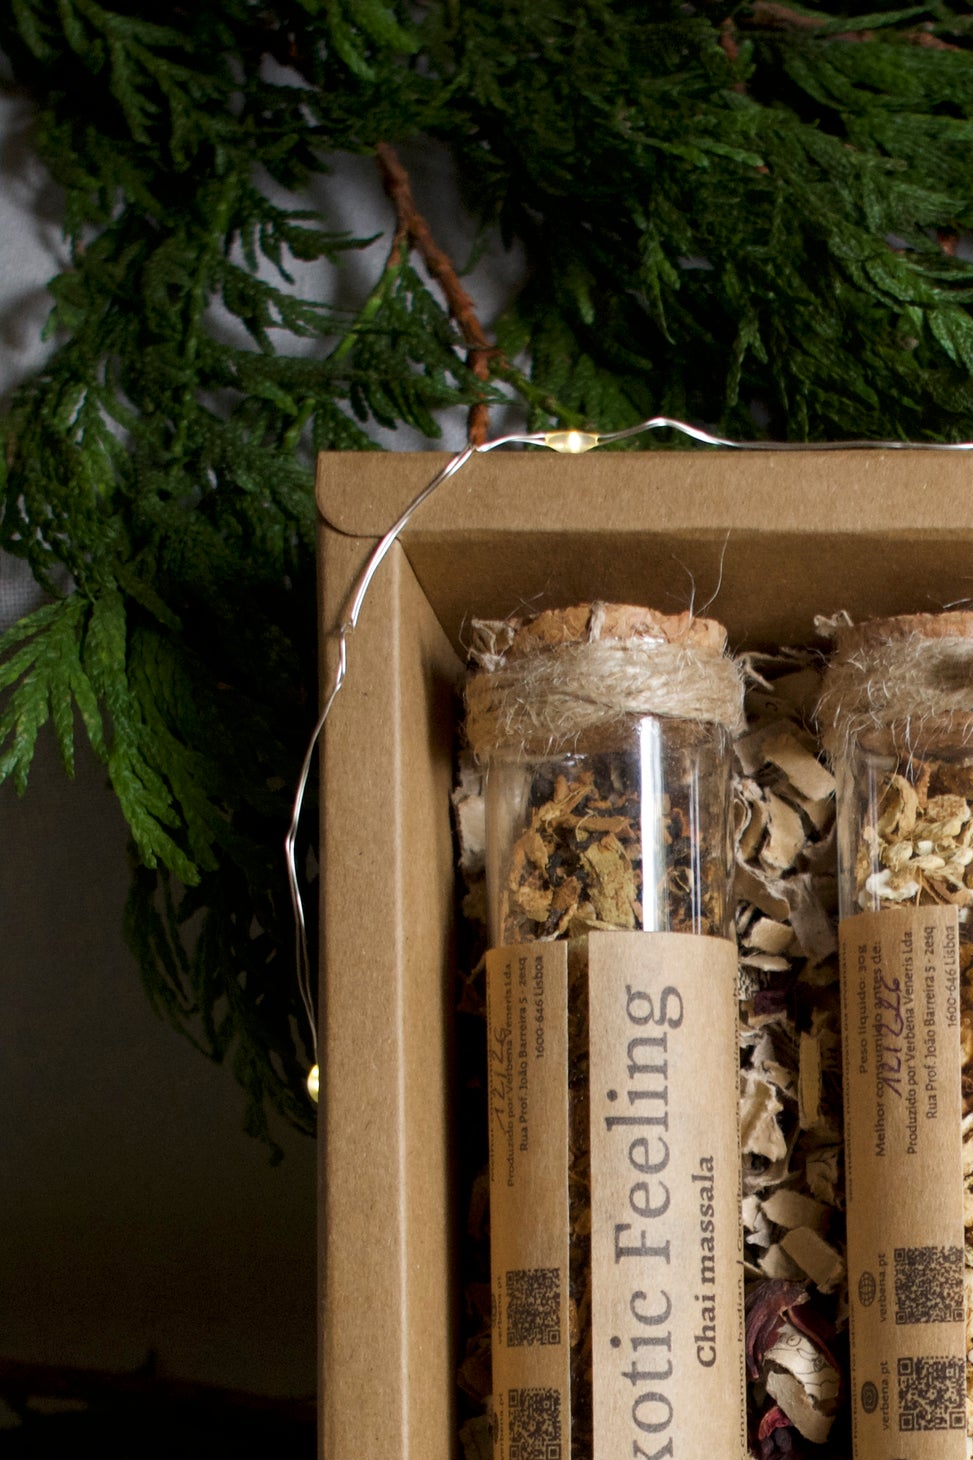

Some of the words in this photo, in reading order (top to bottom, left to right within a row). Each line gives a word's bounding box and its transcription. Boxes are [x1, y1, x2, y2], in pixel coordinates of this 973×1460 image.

[857, 944, 868, 973] 30g
[870, 940, 882, 964] de:
[924, 926, 936, 956] 2esq
[944, 925, 956, 965] Lisboa
[533, 956, 544, 997] Lisboa
[871, 968, 883, 1008] antes
[901, 956, 913, 1005] Veneris
[923, 975, 935, 1027] Barreira
[945, 968, 957, 1028] 1600-646
[503, 988, 513, 1037] Veneris
[534, 999, 545, 1058] 1600-646
[857, 977, 869, 1034] líquido:
[517, 1007, 528, 1059] Barreira
[859, 1039, 868, 1073] Peso
[871, 1014, 886, 1098] consumido
[903, 1008, 916, 1063] Verbena
[924, 1030, 937, 1058] João
[504, 1040, 513, 1095] Verbena
[518, 1061, 529, 1090] João
[906, 1065, 919, 1086] por
[925, 1062, 937, 1091] Prof.
[505, 1096, 516, 1118] por
[519, 1094, 529, 1124] Prof.
[605, 983, 684, 1264] Feeling
[873, 1102, 886, 1157] Melhor
[903, 1089, 917, 1154] Produzido
[926, 1095, 938, 1119] Rua
[504, 1123, 515, 1187] Produzido
[519, 1127, 529, 1152] Rua
[691, 1156, 717, 1286] massala
[877, 1253, 888, 1322] verbena.pt
[691, 1294, 718, 1368] Chai
[879, 1360, 890, 1431] verbena.pt
